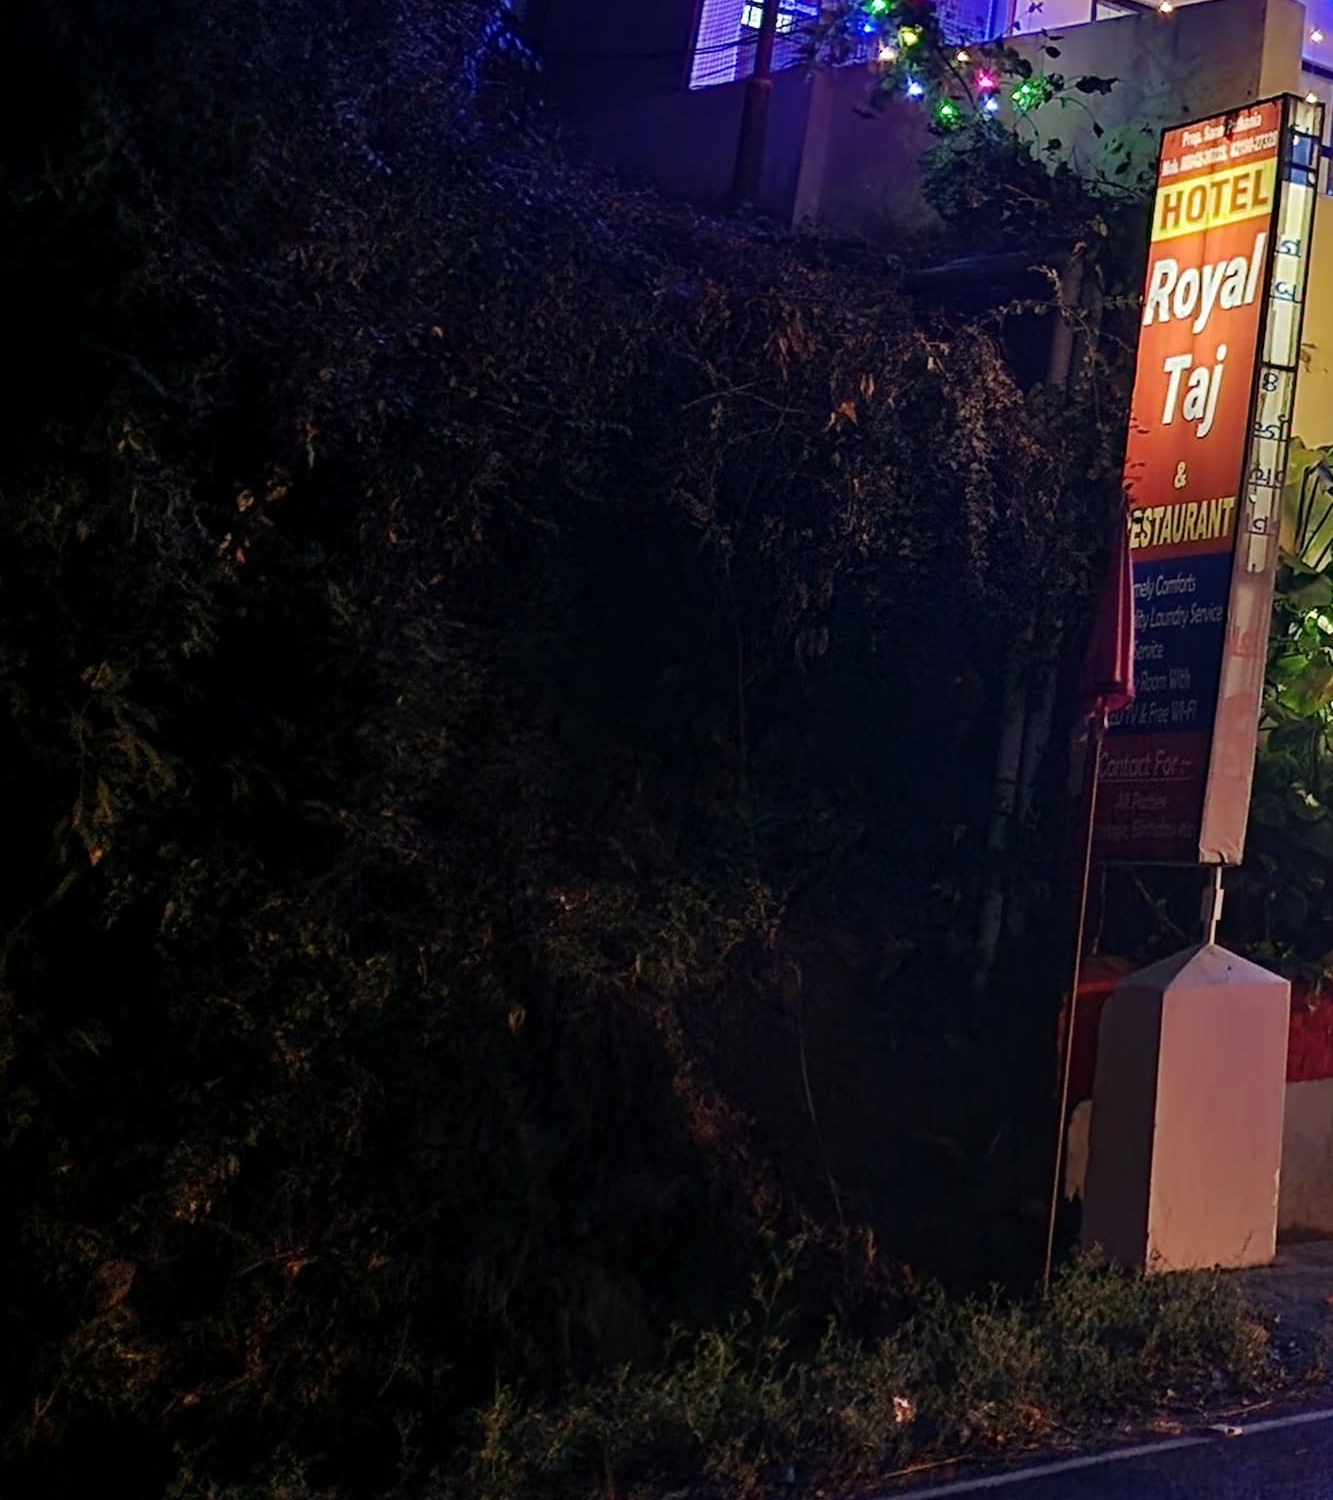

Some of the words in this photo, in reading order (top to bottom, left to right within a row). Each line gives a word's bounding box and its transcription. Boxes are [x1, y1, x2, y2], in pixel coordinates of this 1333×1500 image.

[1160, 168, 1269, 230] HOTEL
[1143, 233, 1266, 334] Royal
[1162, 345, 1227, 438] Taj
[1174, 461, 1188, 489] &
[1128, 497, 1235, 549] ESTAURANT
[1155, 572, 1197, 596] Comforts
[1189, 602, 1224, 625] Service
